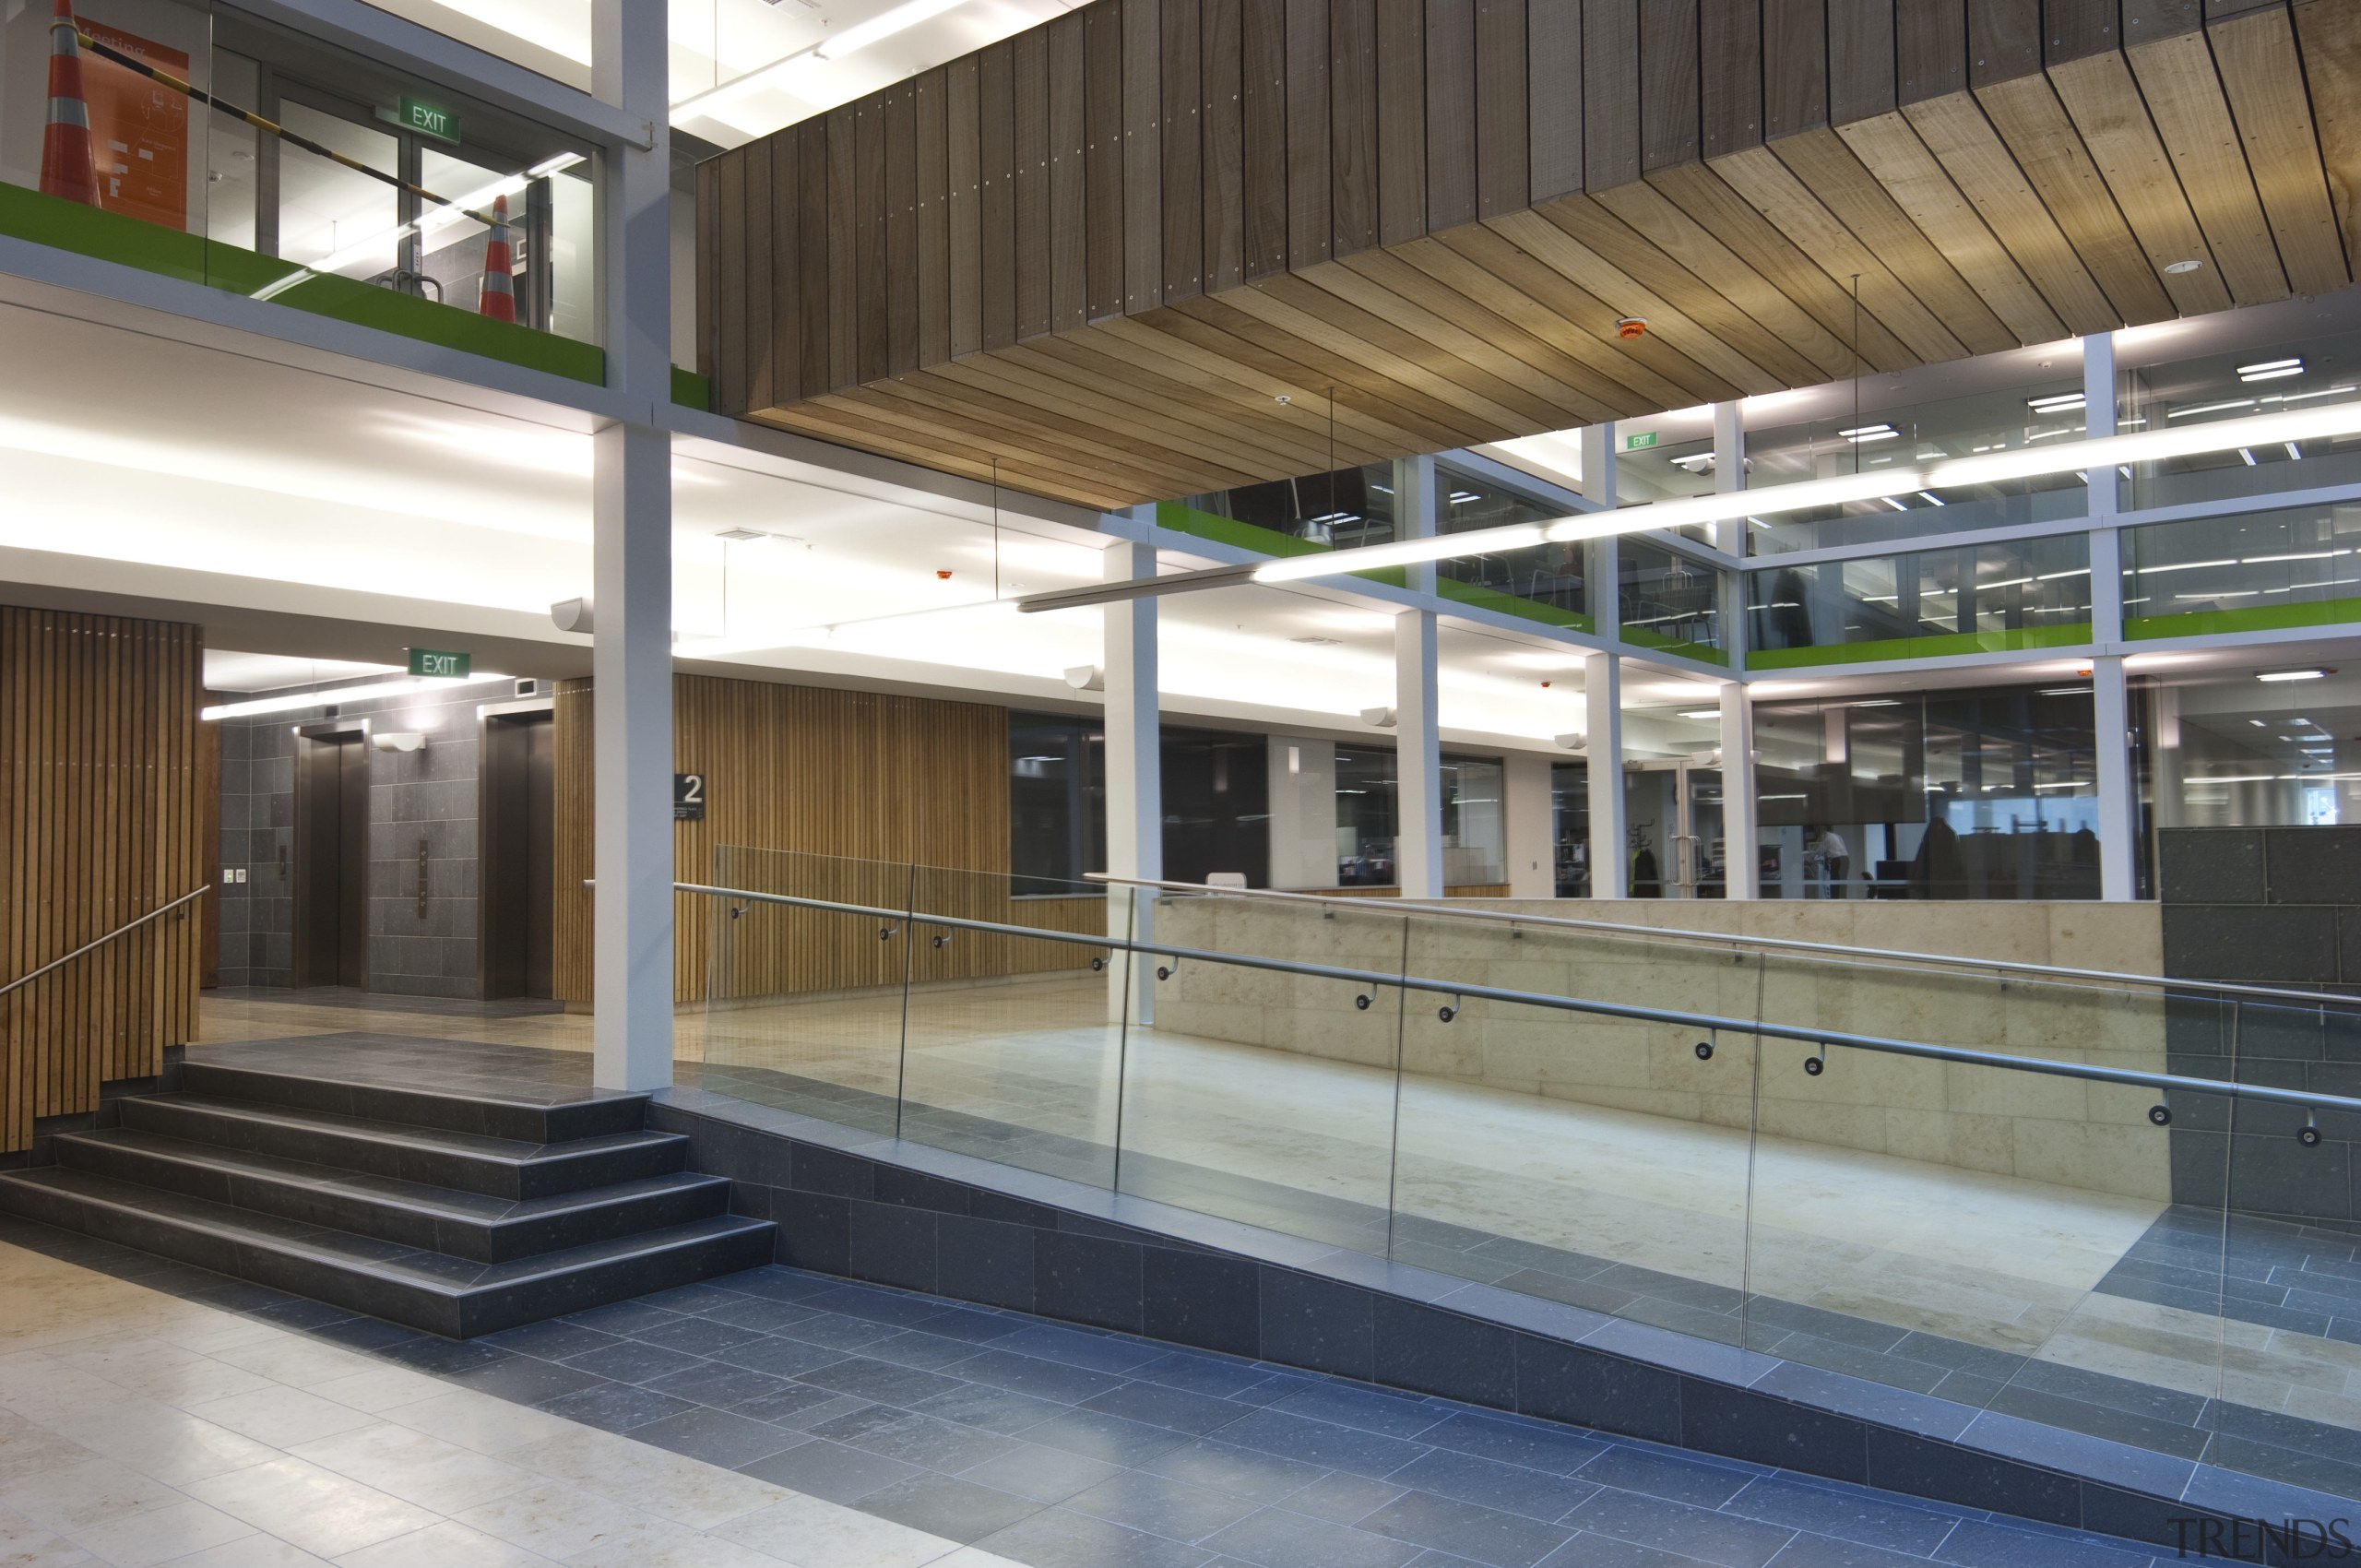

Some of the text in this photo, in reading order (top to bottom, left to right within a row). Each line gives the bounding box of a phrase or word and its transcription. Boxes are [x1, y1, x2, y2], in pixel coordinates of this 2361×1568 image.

[412, 105, 446, 133] EXIT
[1633, 434, 1651, 447] EXIT
[422, 654, 457, 675] EXIT
[684, 775, 703, 802] 2
